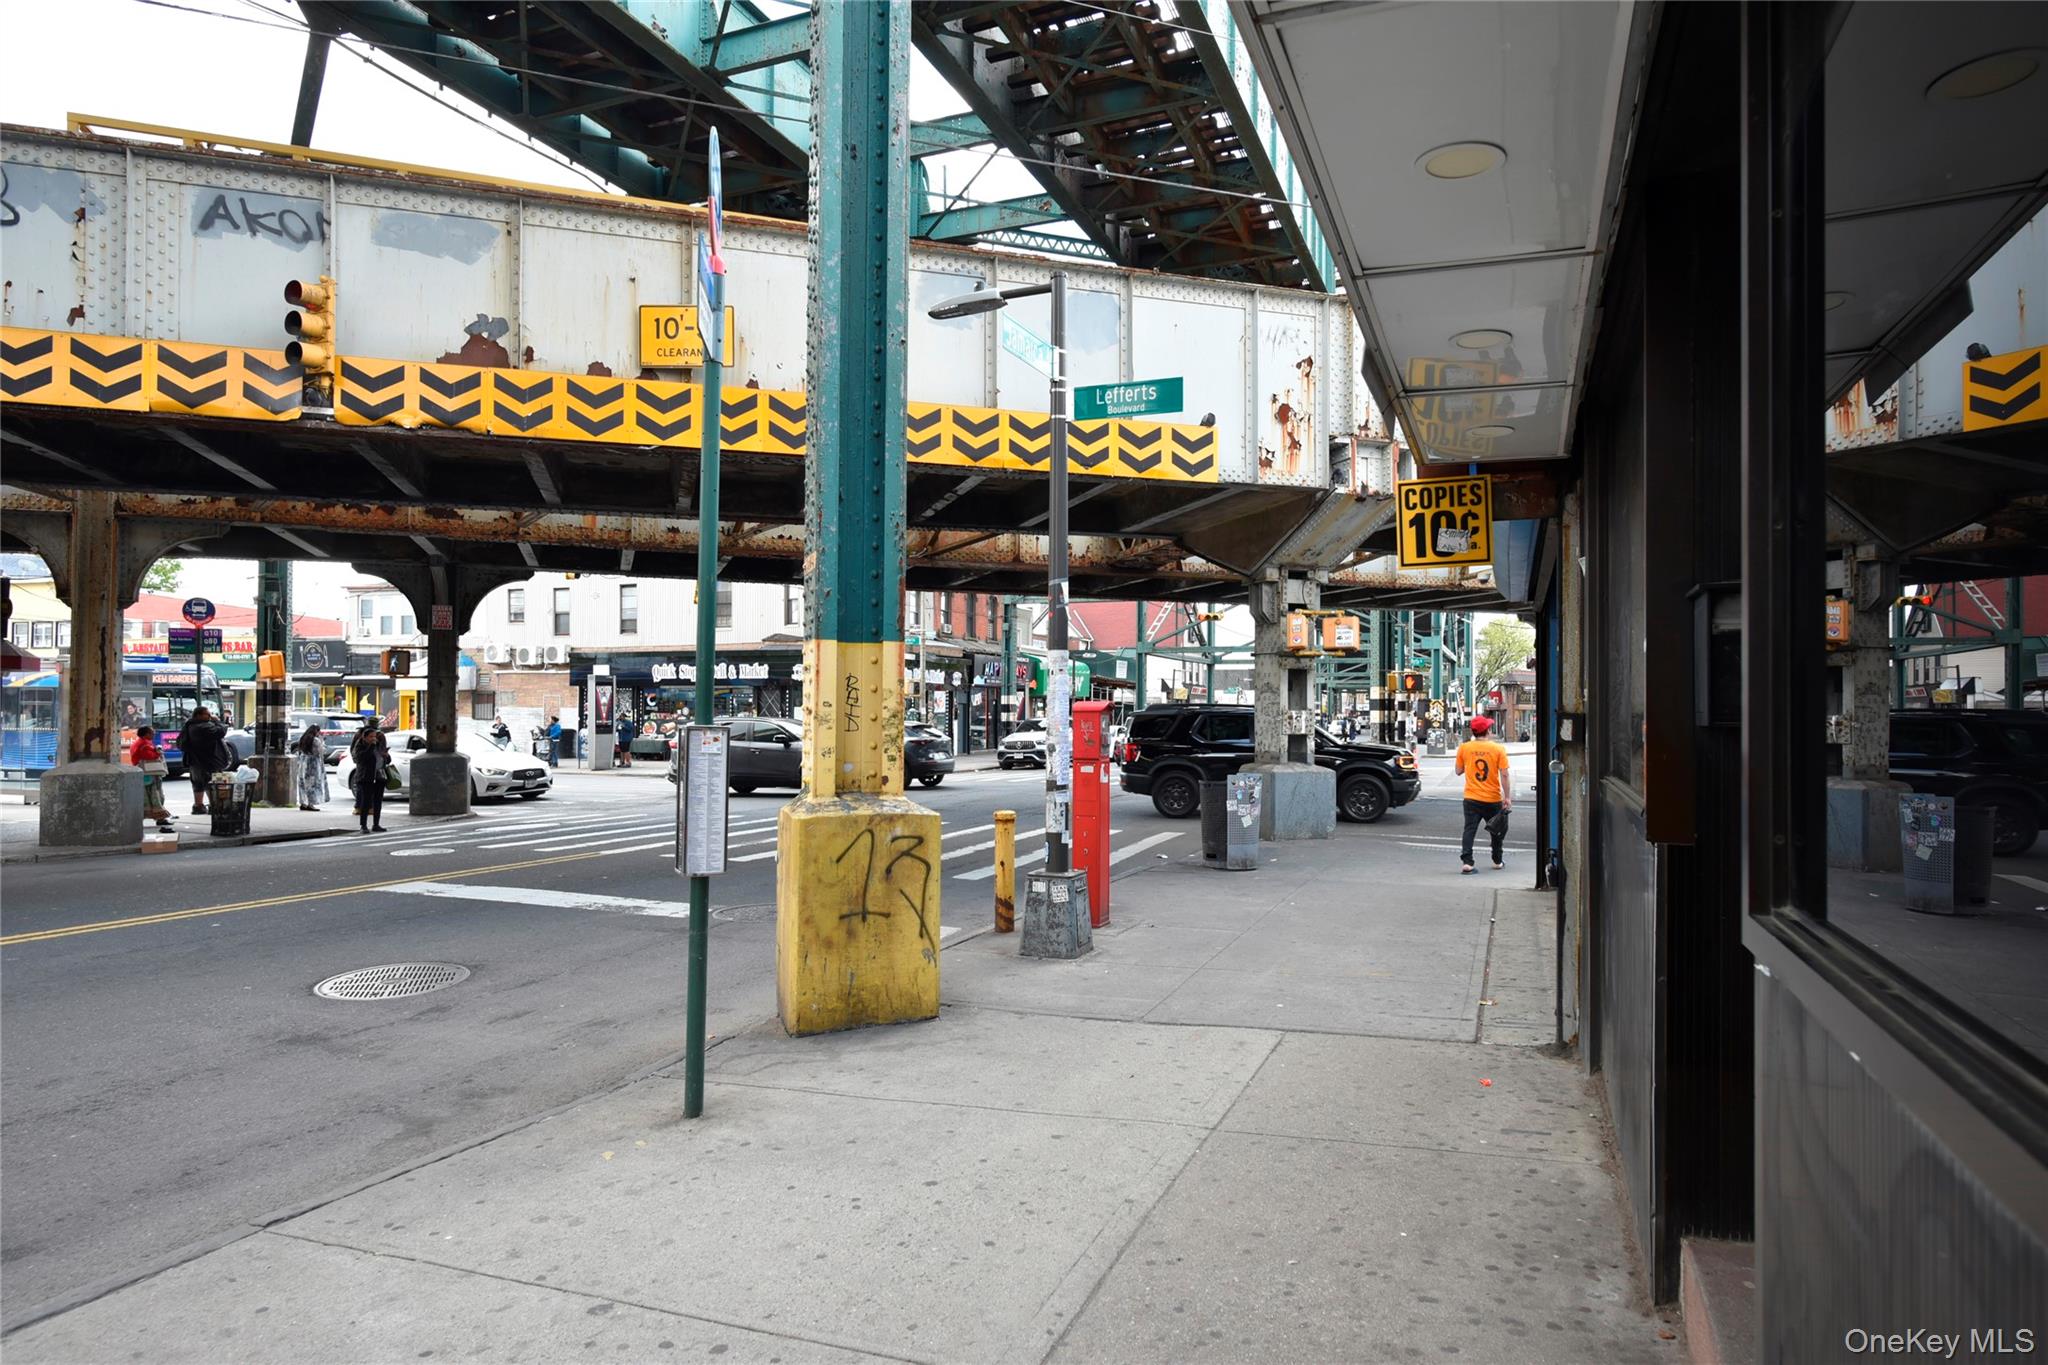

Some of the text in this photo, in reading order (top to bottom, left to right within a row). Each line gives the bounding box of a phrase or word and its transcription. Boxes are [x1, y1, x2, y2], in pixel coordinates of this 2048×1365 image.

[654, 314, 701, 340] 10'-
[656, 347, 703, 358] CLEARAN
[1096, 385, 1157, 405] Lefferts
[1107, 404, 1145, 415] Boulevard
[1404, 483, 1482, 511] COPIES
[235, 641, 253, 653] BAR
[168, 674, 197, 684] GARDEN
[652, 663, 677, 682] Quick
[729, 664, 737, 679] &
[739, 662, 769, 679] Market
[1475, 759, 1489, 783] 9
